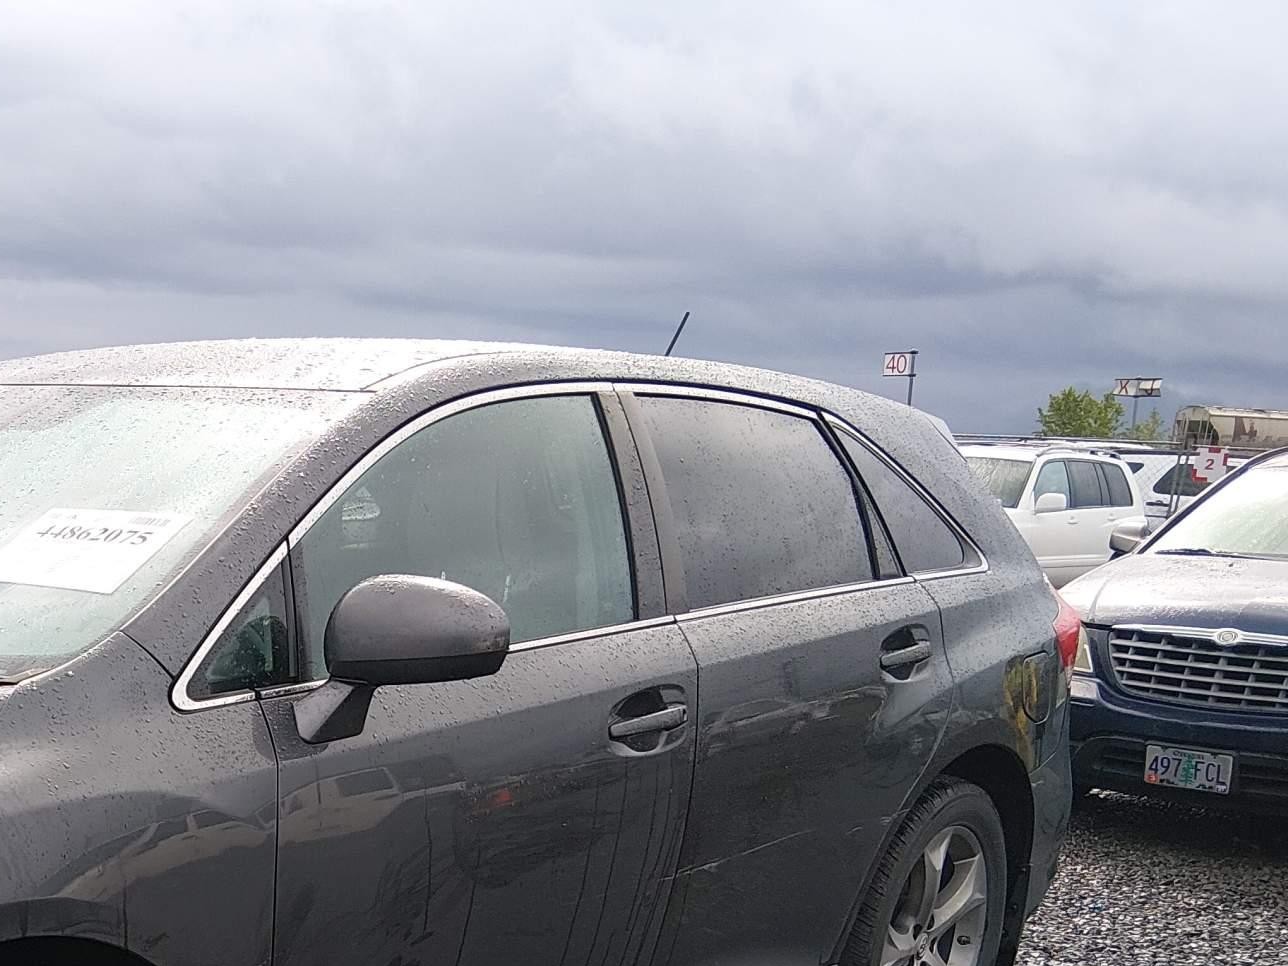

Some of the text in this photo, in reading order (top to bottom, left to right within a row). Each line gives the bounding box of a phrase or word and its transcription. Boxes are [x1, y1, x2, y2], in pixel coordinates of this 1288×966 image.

[885, 354, 908, 374] 40
[1119, 380, 1130, 394] K
[1205, 459, 1215, 470] 2
[36, 524, 154, 545] 44862075
[1148, 755, 1226, 785] 497 FCL
